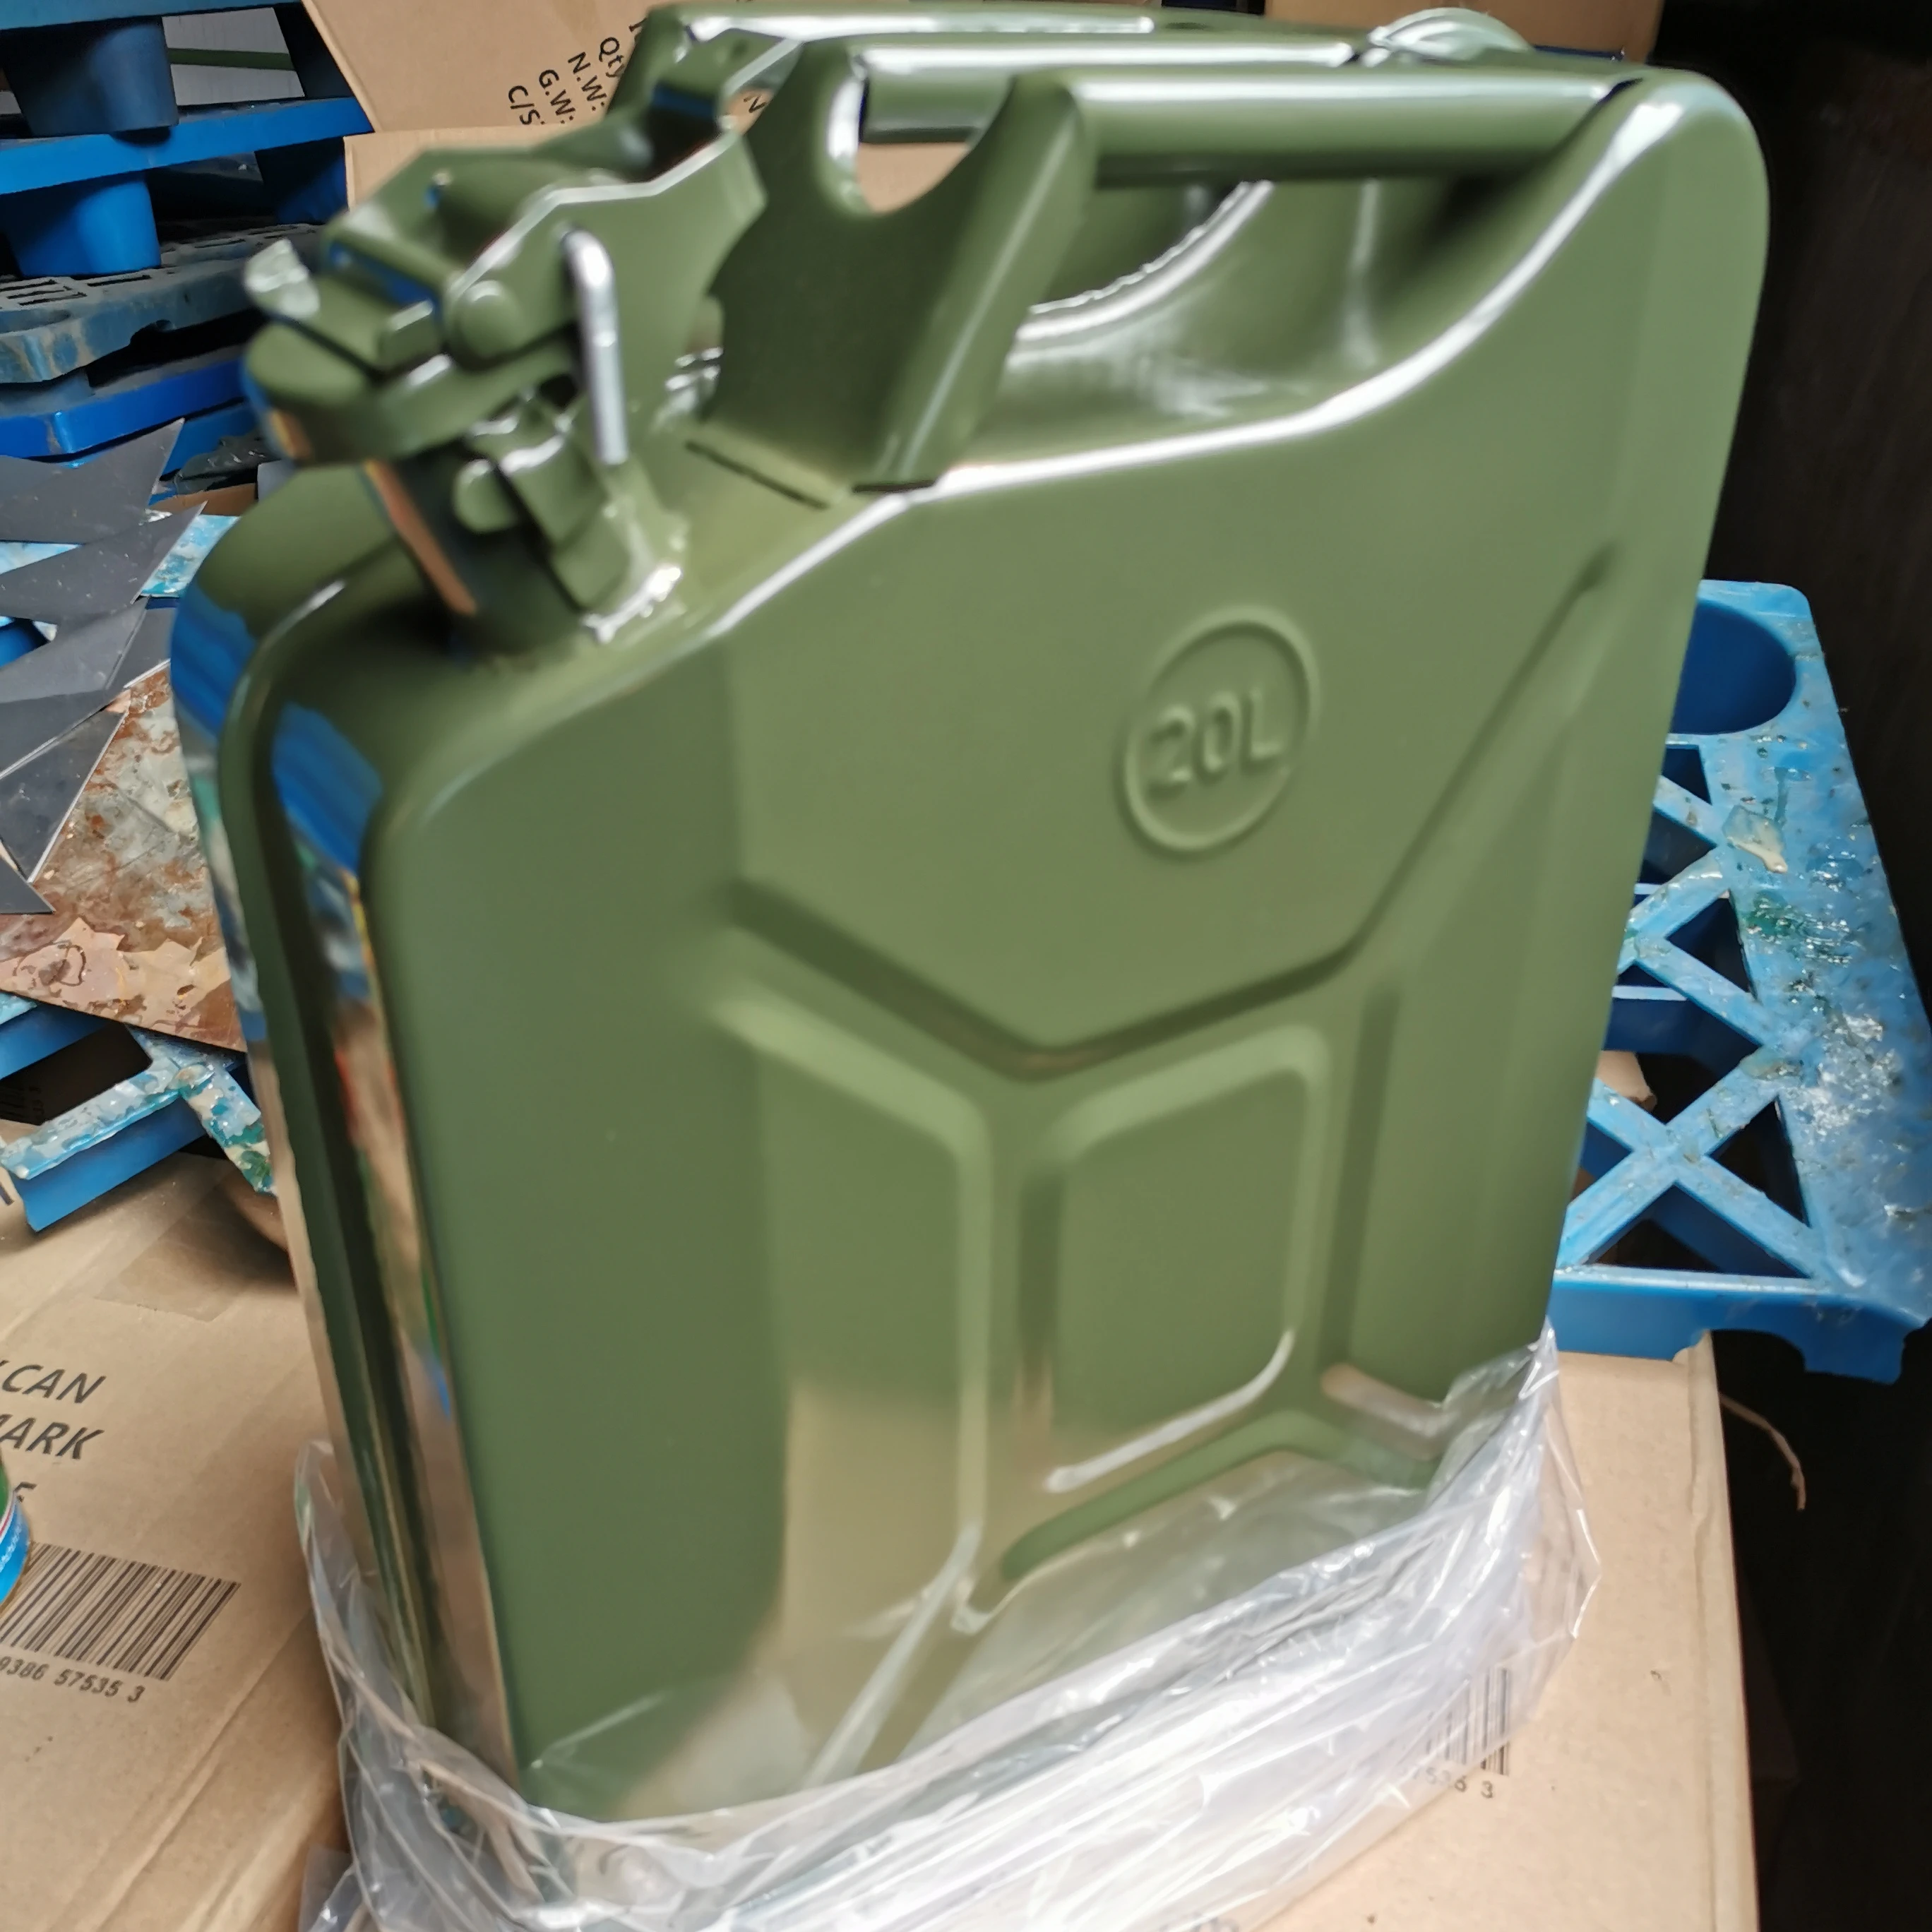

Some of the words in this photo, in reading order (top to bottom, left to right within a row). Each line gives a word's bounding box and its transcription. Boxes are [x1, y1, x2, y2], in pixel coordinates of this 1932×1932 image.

[1145, 686, 1284, 802] 20L
[54, 1668, 123, 1697] 57535
[127, 1685, 146, 1703] 3
[1481, 1780, 1493, 1799] 3
